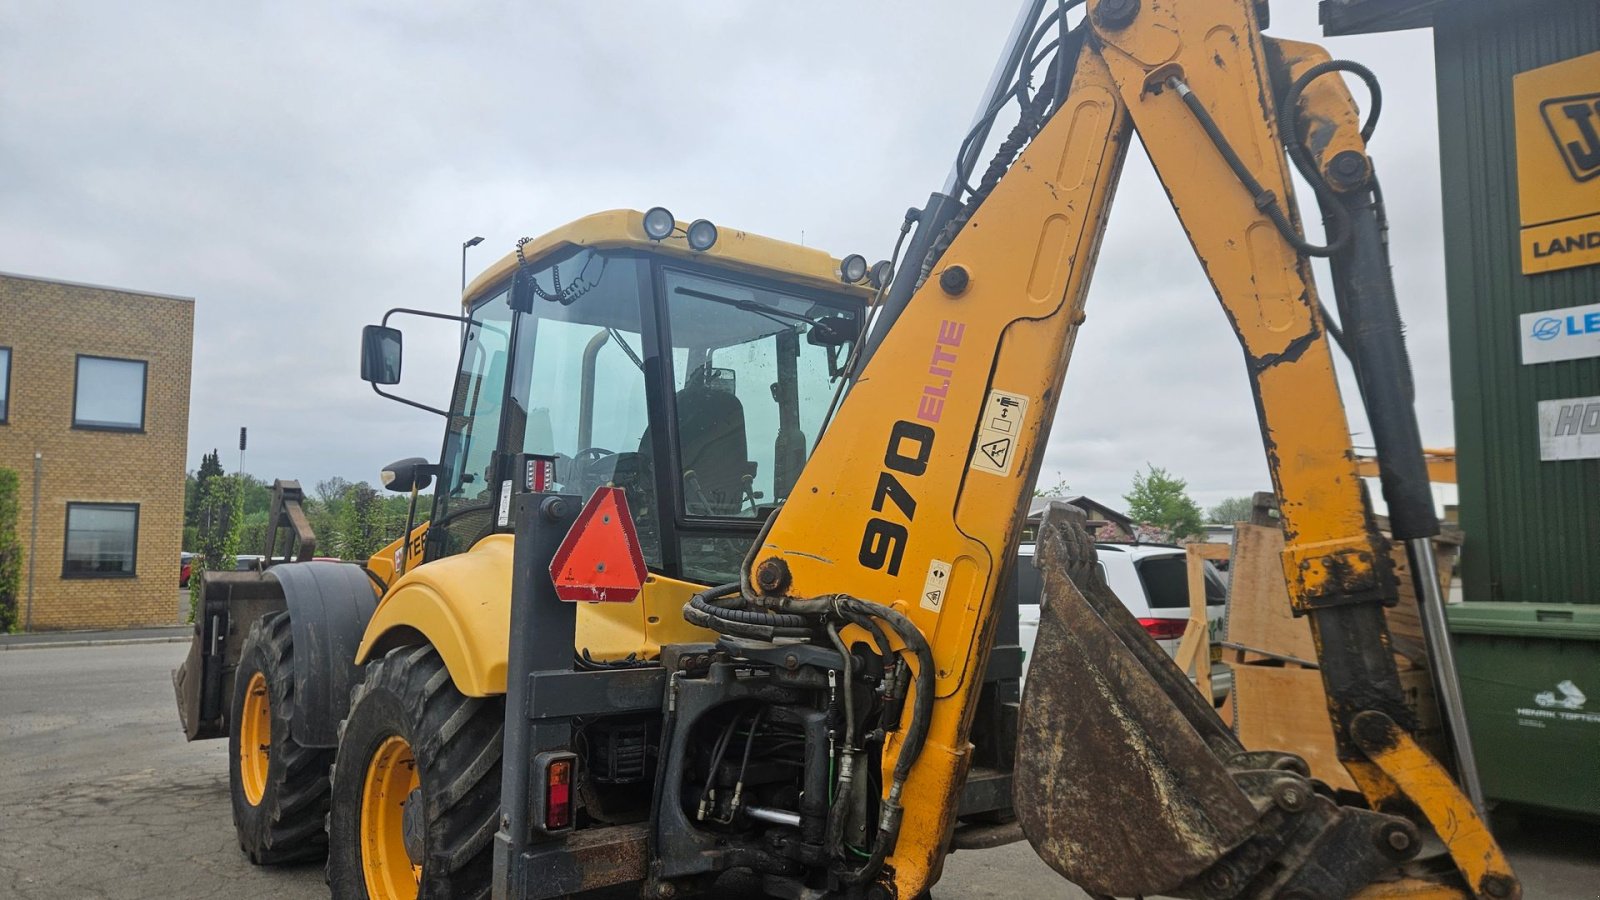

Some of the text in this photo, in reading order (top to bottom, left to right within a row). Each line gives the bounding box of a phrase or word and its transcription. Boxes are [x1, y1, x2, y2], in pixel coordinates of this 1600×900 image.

[1563, 101, 1600, 170] J
[1566, 312, 1600, 336] LE
[858, 319, 966, 577] 970 ELITE
[1517, 708, 1556, 718] HENRIK
